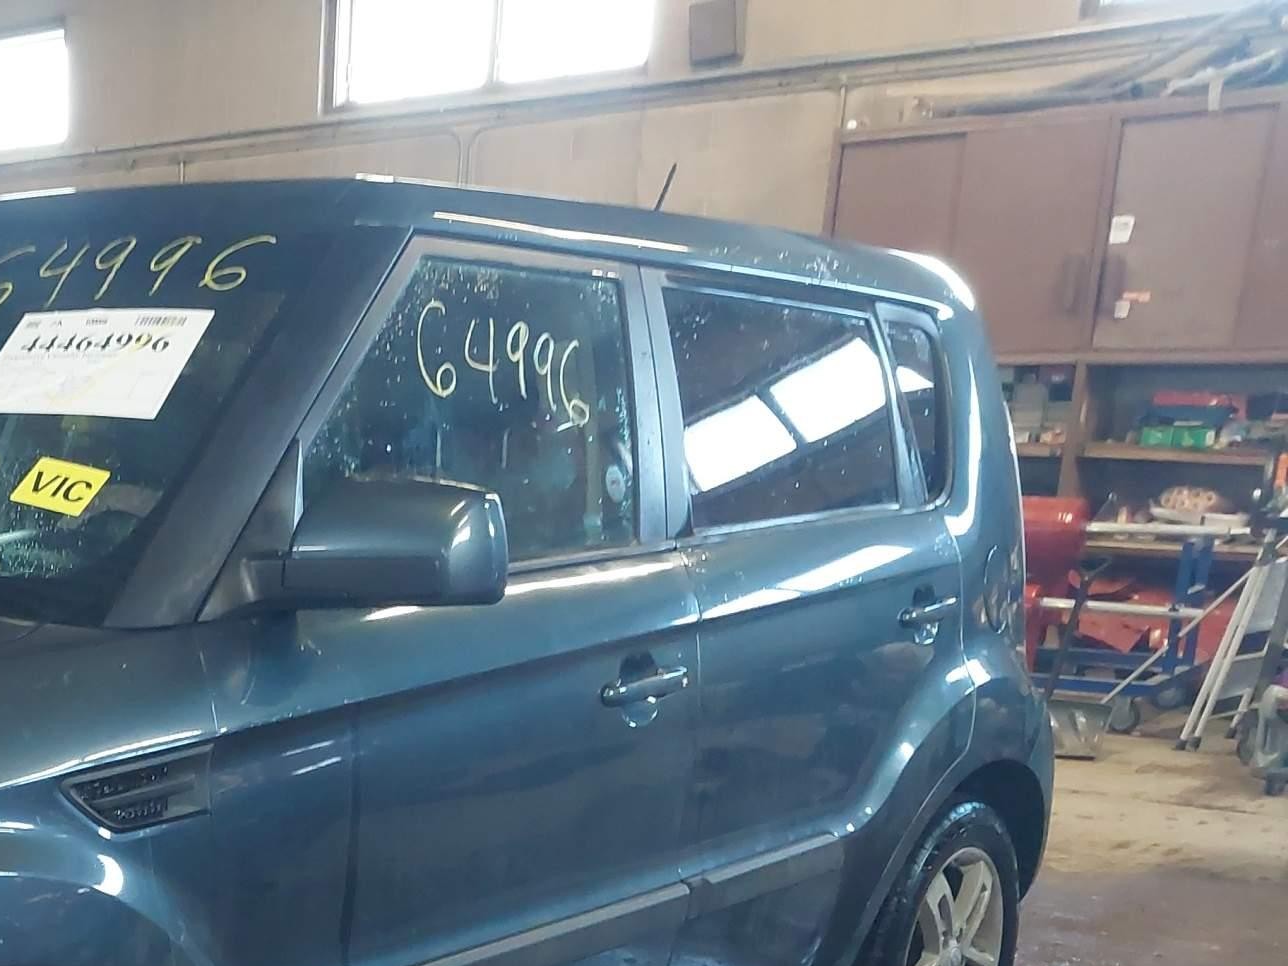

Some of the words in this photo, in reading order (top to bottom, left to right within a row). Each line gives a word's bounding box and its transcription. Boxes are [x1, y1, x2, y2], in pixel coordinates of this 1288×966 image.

[20, 331, 171, 353] 44464996
[416, 298, 590, 432] 64996
[31, 470, 93, 503] VIC
